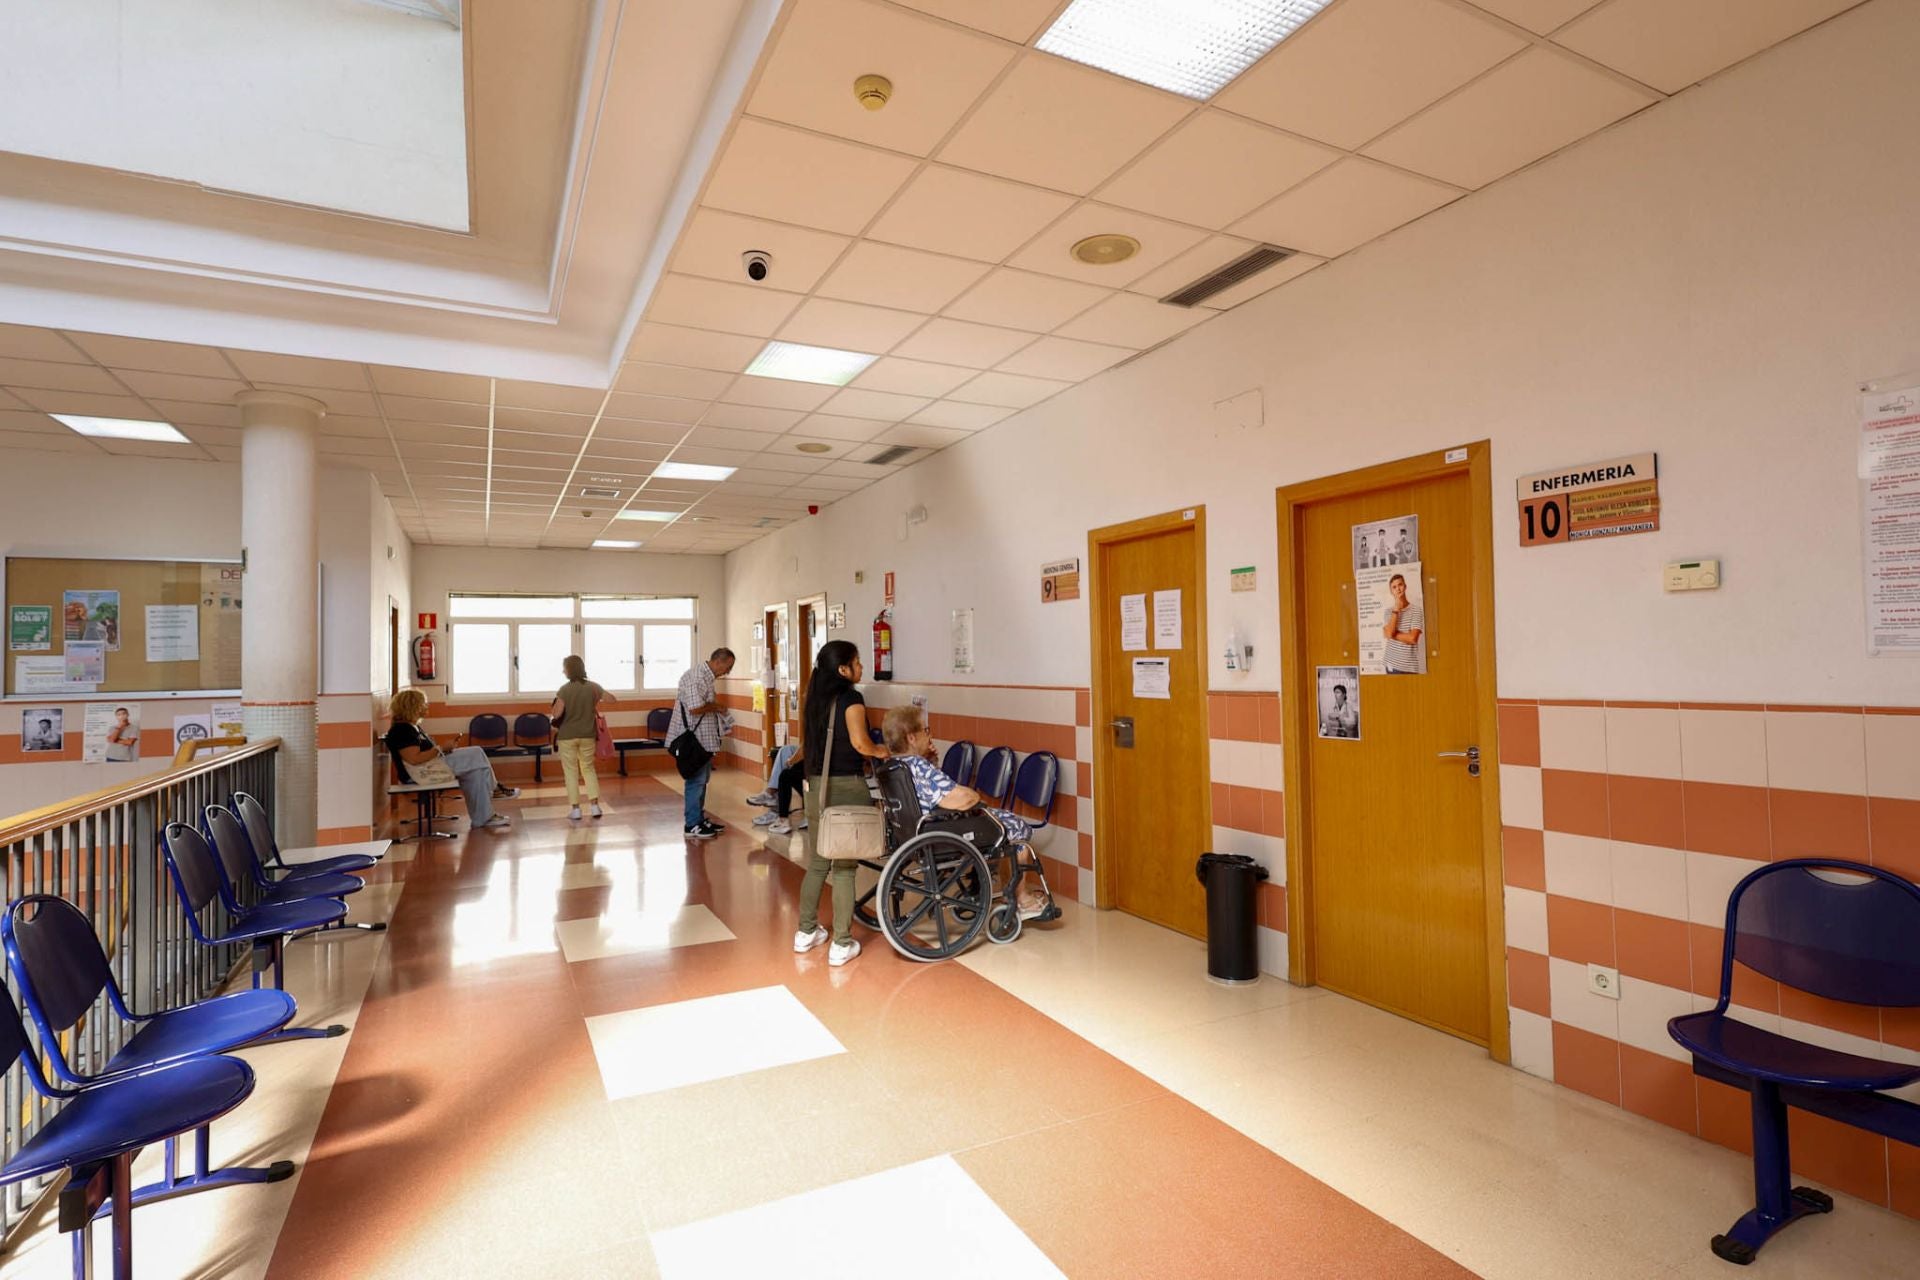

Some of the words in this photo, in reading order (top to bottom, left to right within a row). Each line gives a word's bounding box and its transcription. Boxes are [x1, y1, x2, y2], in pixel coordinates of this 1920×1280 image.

[1532, 464, 1635, 493] ENFERMERIA
[1524, 500, 1561, 540] 10
[1044, 580, 1052, 598] 9
